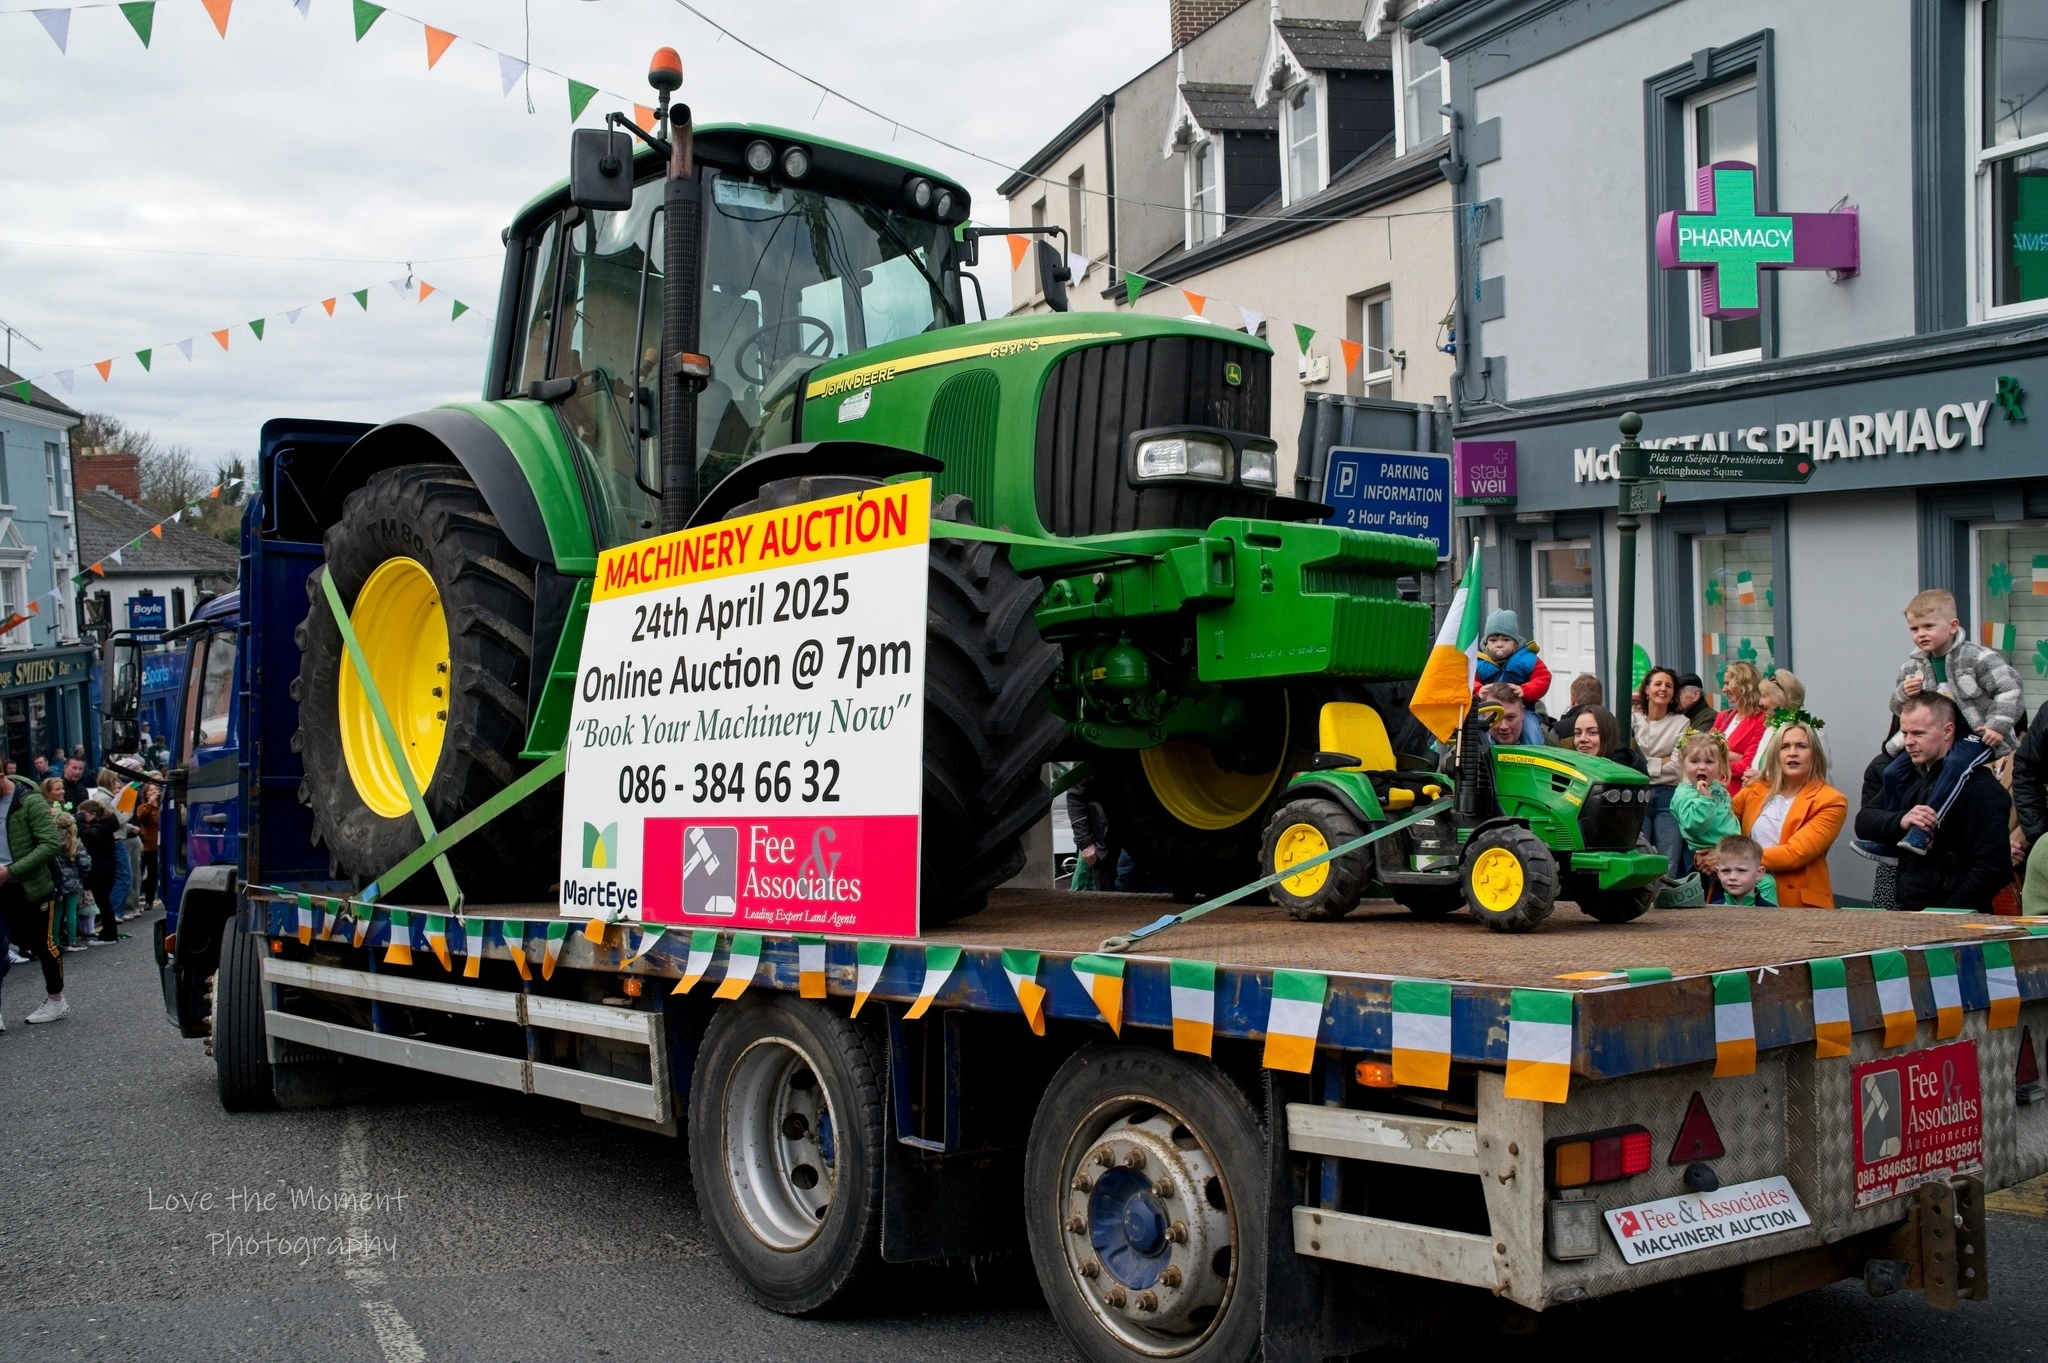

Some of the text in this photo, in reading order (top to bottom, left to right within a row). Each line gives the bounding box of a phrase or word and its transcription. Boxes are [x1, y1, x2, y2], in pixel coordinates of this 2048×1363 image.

[1679, 229, 1791, 248] PHARMACY
[1029, 339, 1039, 351] S
[821, 367, 895, 398] JOHN DEERE
[1574, 400, 1993, 483] McCAL'S PHARMACY
[1380, 463, 1429, 480] PARKING
[1471, 464, 1506, 479] stay
[1649, 453, 1670, 463] Plás
[1719, 454, 1784, 465] Presbitéireach
[1649, 466, 1743, 478] Meetinghouse Square
[1339, 466, 1353, 493] P
[1363, 485, 1442, 502] INFORMATION
[1471, 480, 1506, 493] well
[1347, 509, 1429, 528] 2 Hour Parking
[603, 494, 908, 591] MACHINERY AUCTION
[134, 604, 162, 615] Boyle
[631, 572, 849, 642] 24th April 2025
[15, 659, 54, 685] SMITH'S
[59, 661, 70, 675] Bar
[141, 665, 168, 688] eSports
[583, 636, 911, 702] Online Auction @ 7pm
[576, 693, 911, 748] “Book Your Machinery Now”
[1501, 755, 1535, 764] JOHN DEERE
[619, 759, 840, 804] 086 - 384 66 32
[749, 826, 842, 900] Fee &
[564, 879, 638, 913] MartEye
[743, 866, 861, 901] Associates
[744, 907, 856, 927] Leading Expert Land Agents
[1908, 1064, 1939, 1102] Fee
[1907, 1096, 1978, 1134] Associates
[1907, 1123, 1979, 1152] Auctioneers
[1857, 1167, 1875, 1189] 086
[1877, 1156, 1917, 1180] 3846632
[1925, 1151, 1943, 1167] 042
[1945, 1138, 1982, 1162] 9329911
[1641, 1188, 1790, 1232] Fee & Associates
[1633, 1209, 1798, 1256] MACHINERY AUCTION
